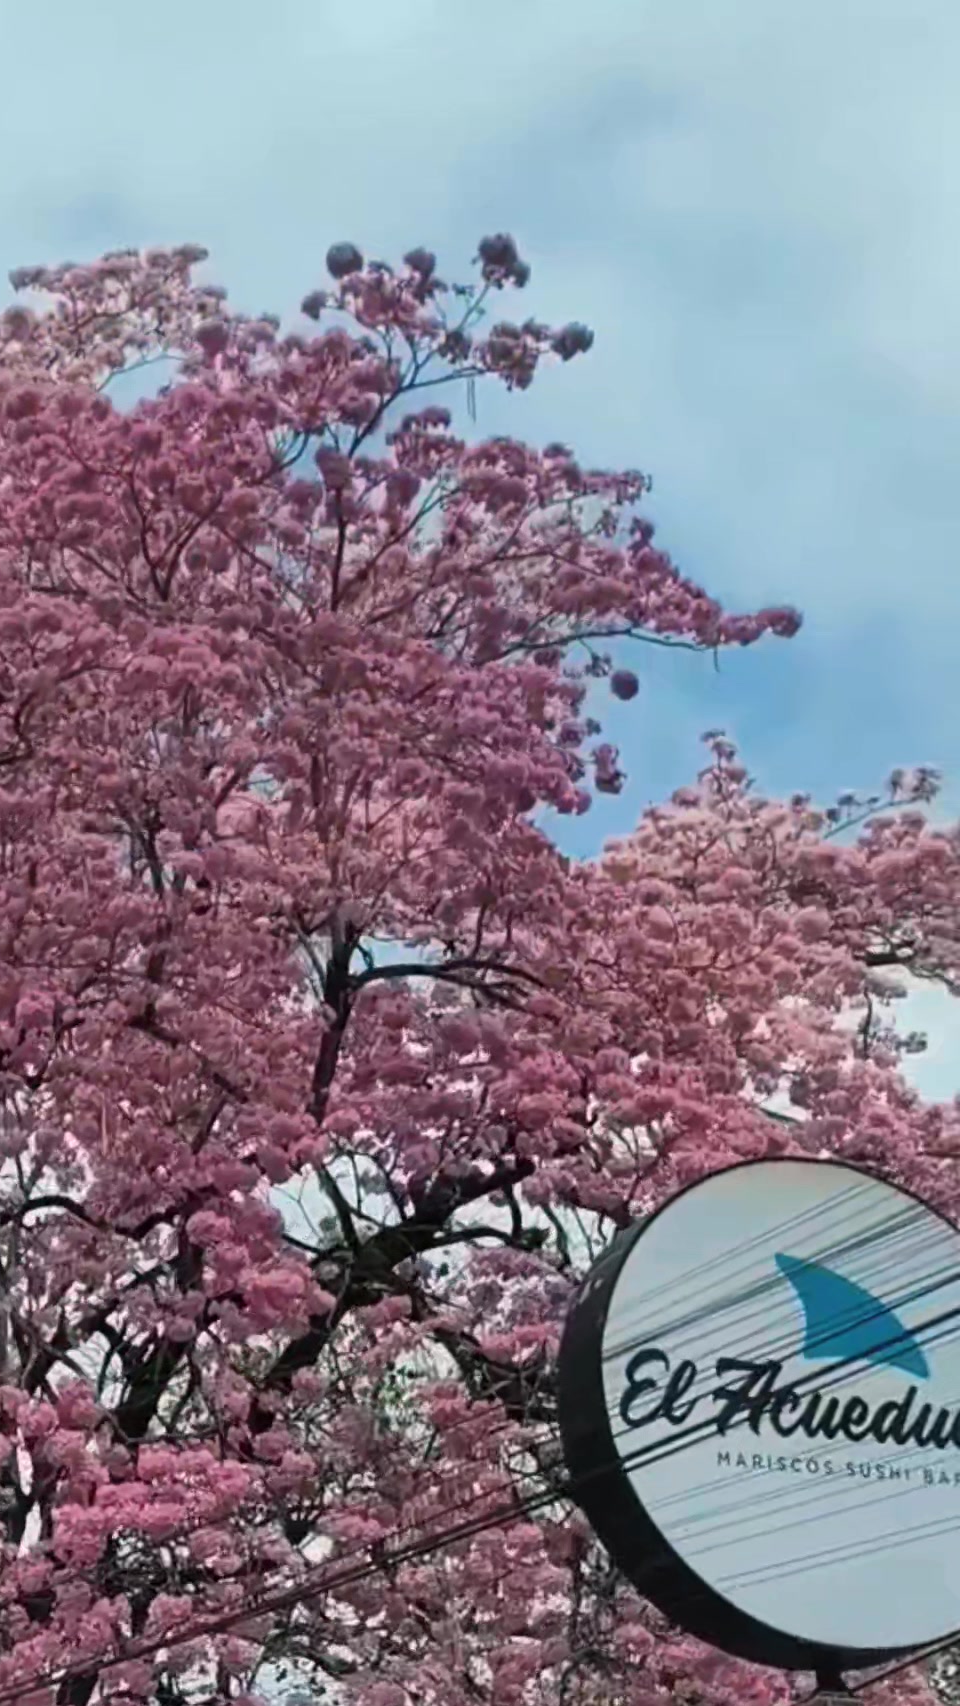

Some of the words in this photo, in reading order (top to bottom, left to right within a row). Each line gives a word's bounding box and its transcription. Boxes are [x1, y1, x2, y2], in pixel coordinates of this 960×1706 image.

[619, 1347, 696, 1428] El
[716, 1450, 834, 1475] MARISCOS
[846, 1461, 910, 1481] SUSHI
